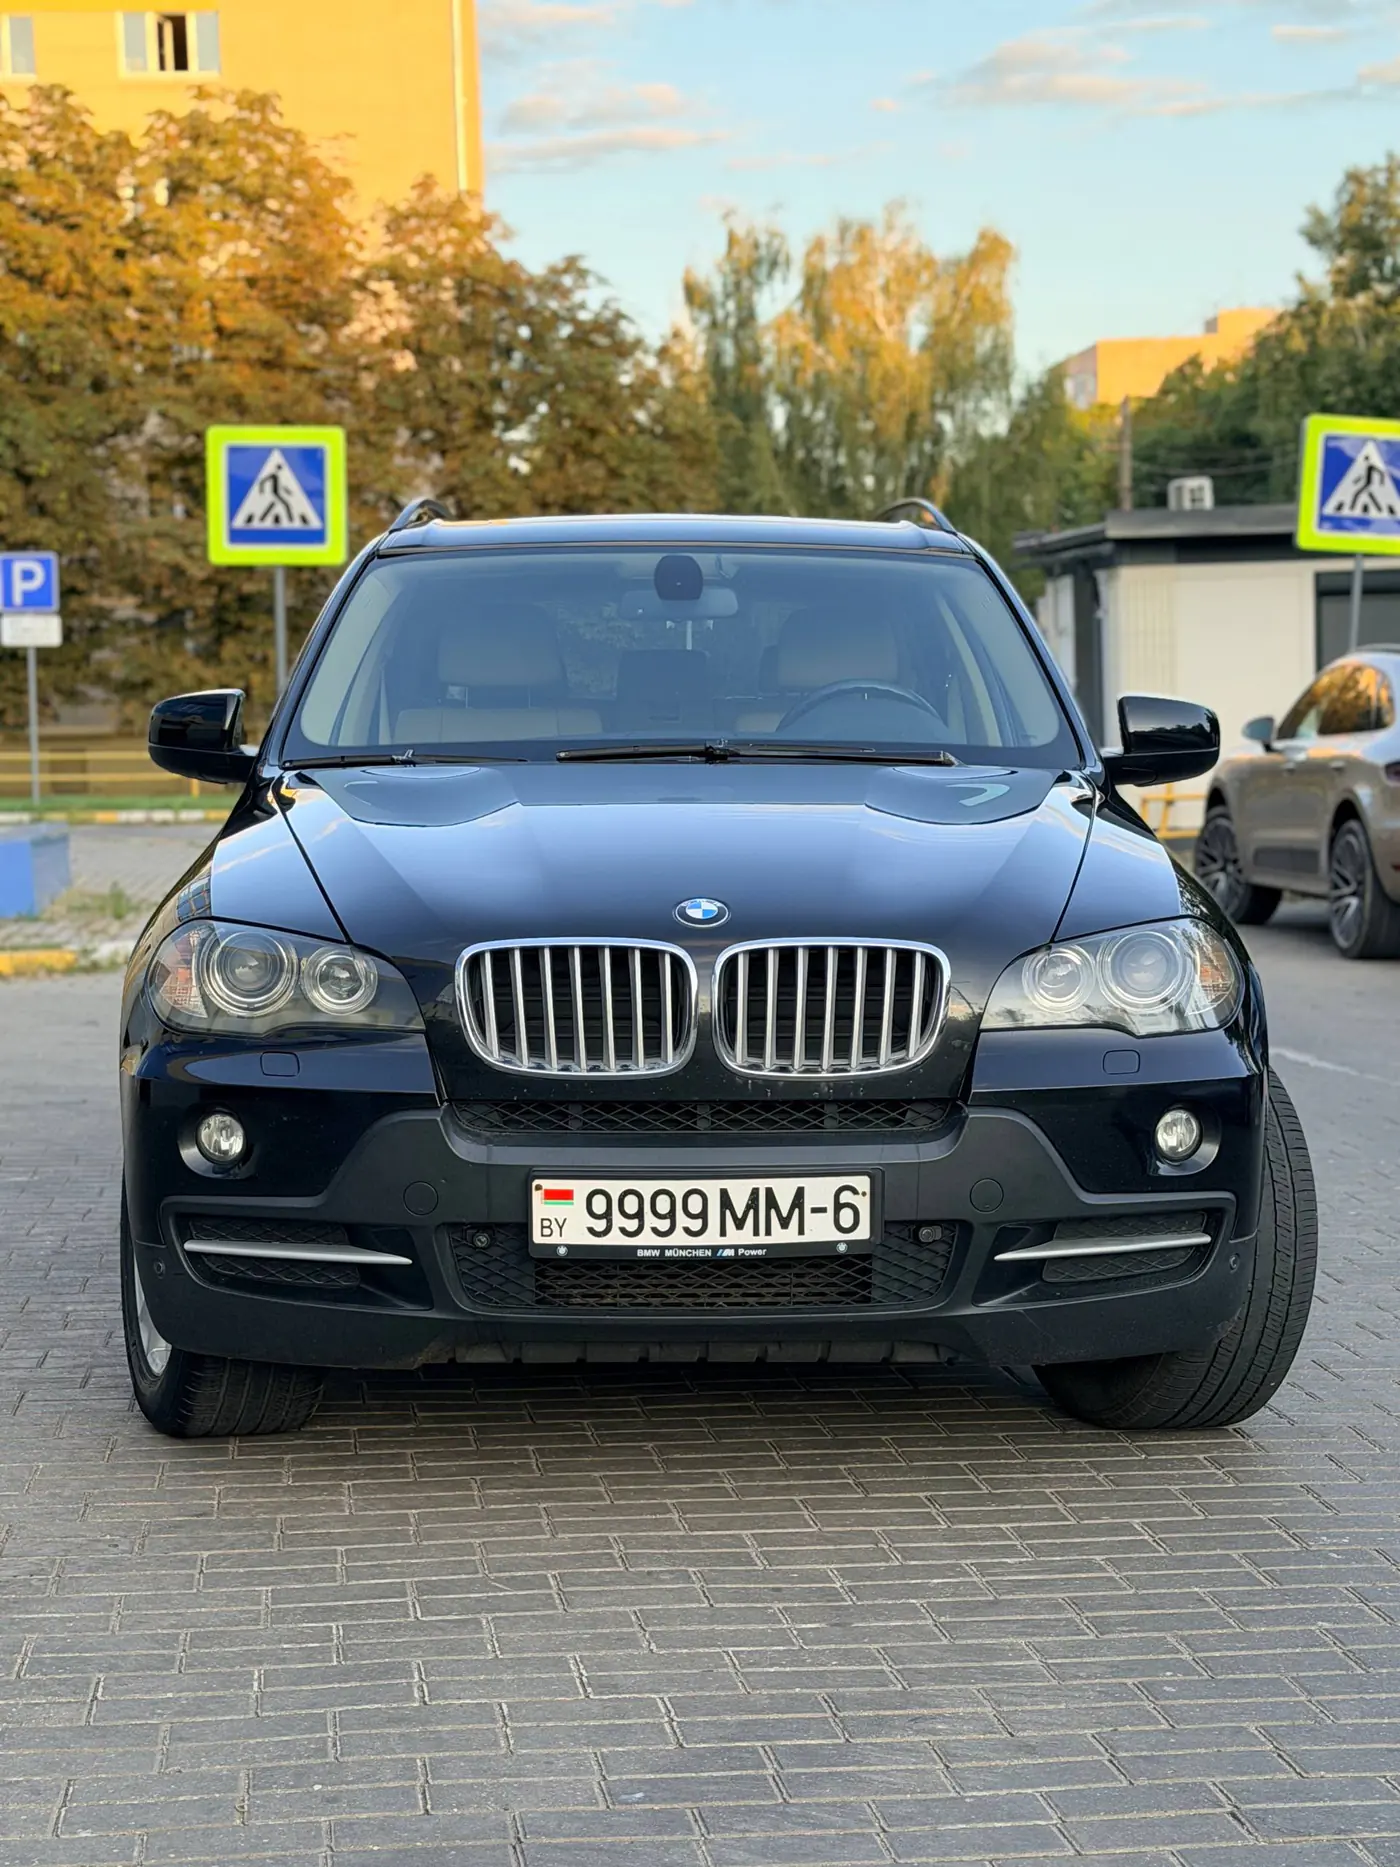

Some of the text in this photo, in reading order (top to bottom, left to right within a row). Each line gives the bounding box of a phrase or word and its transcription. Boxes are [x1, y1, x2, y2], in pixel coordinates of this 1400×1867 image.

[12, 560, 45, 606] P
[540, 1218, 567, 1238] BY
[637, 1249, 660, 1257] BMW
[665, 1248, 712, 1257] MÜNCHEN
[738, 1248, 767, 1256] Power
